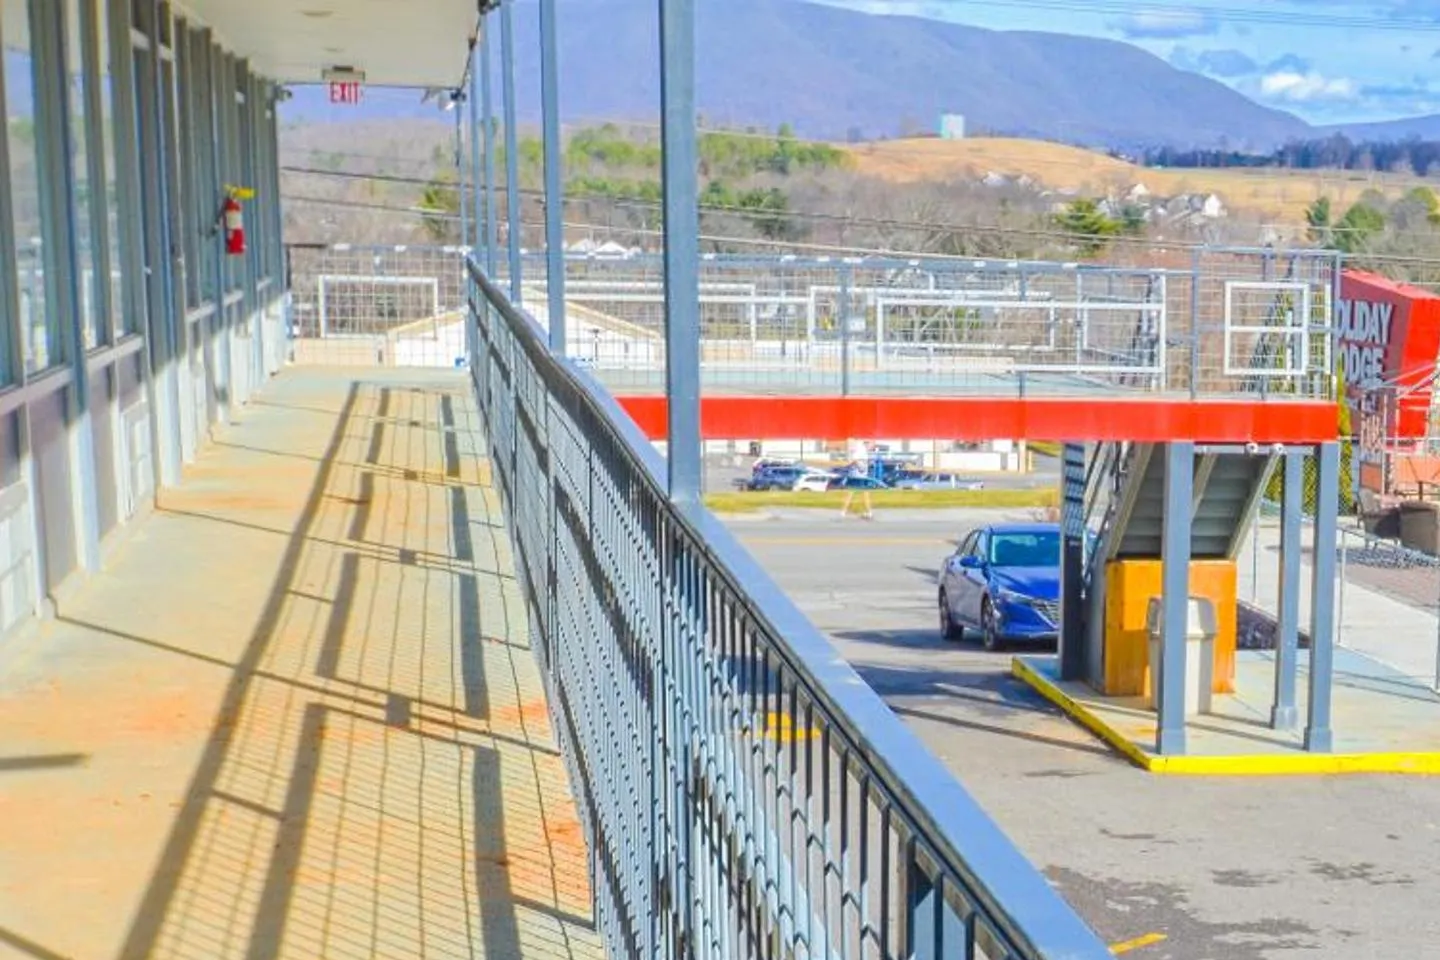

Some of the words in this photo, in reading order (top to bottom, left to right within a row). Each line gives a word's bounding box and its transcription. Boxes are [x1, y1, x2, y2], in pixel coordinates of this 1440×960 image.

[330, 81, 359, 104] EXIT
[1334, 299, 1393, 345] OLIDAY
[1338, 343, 1385, 383] ODGE
